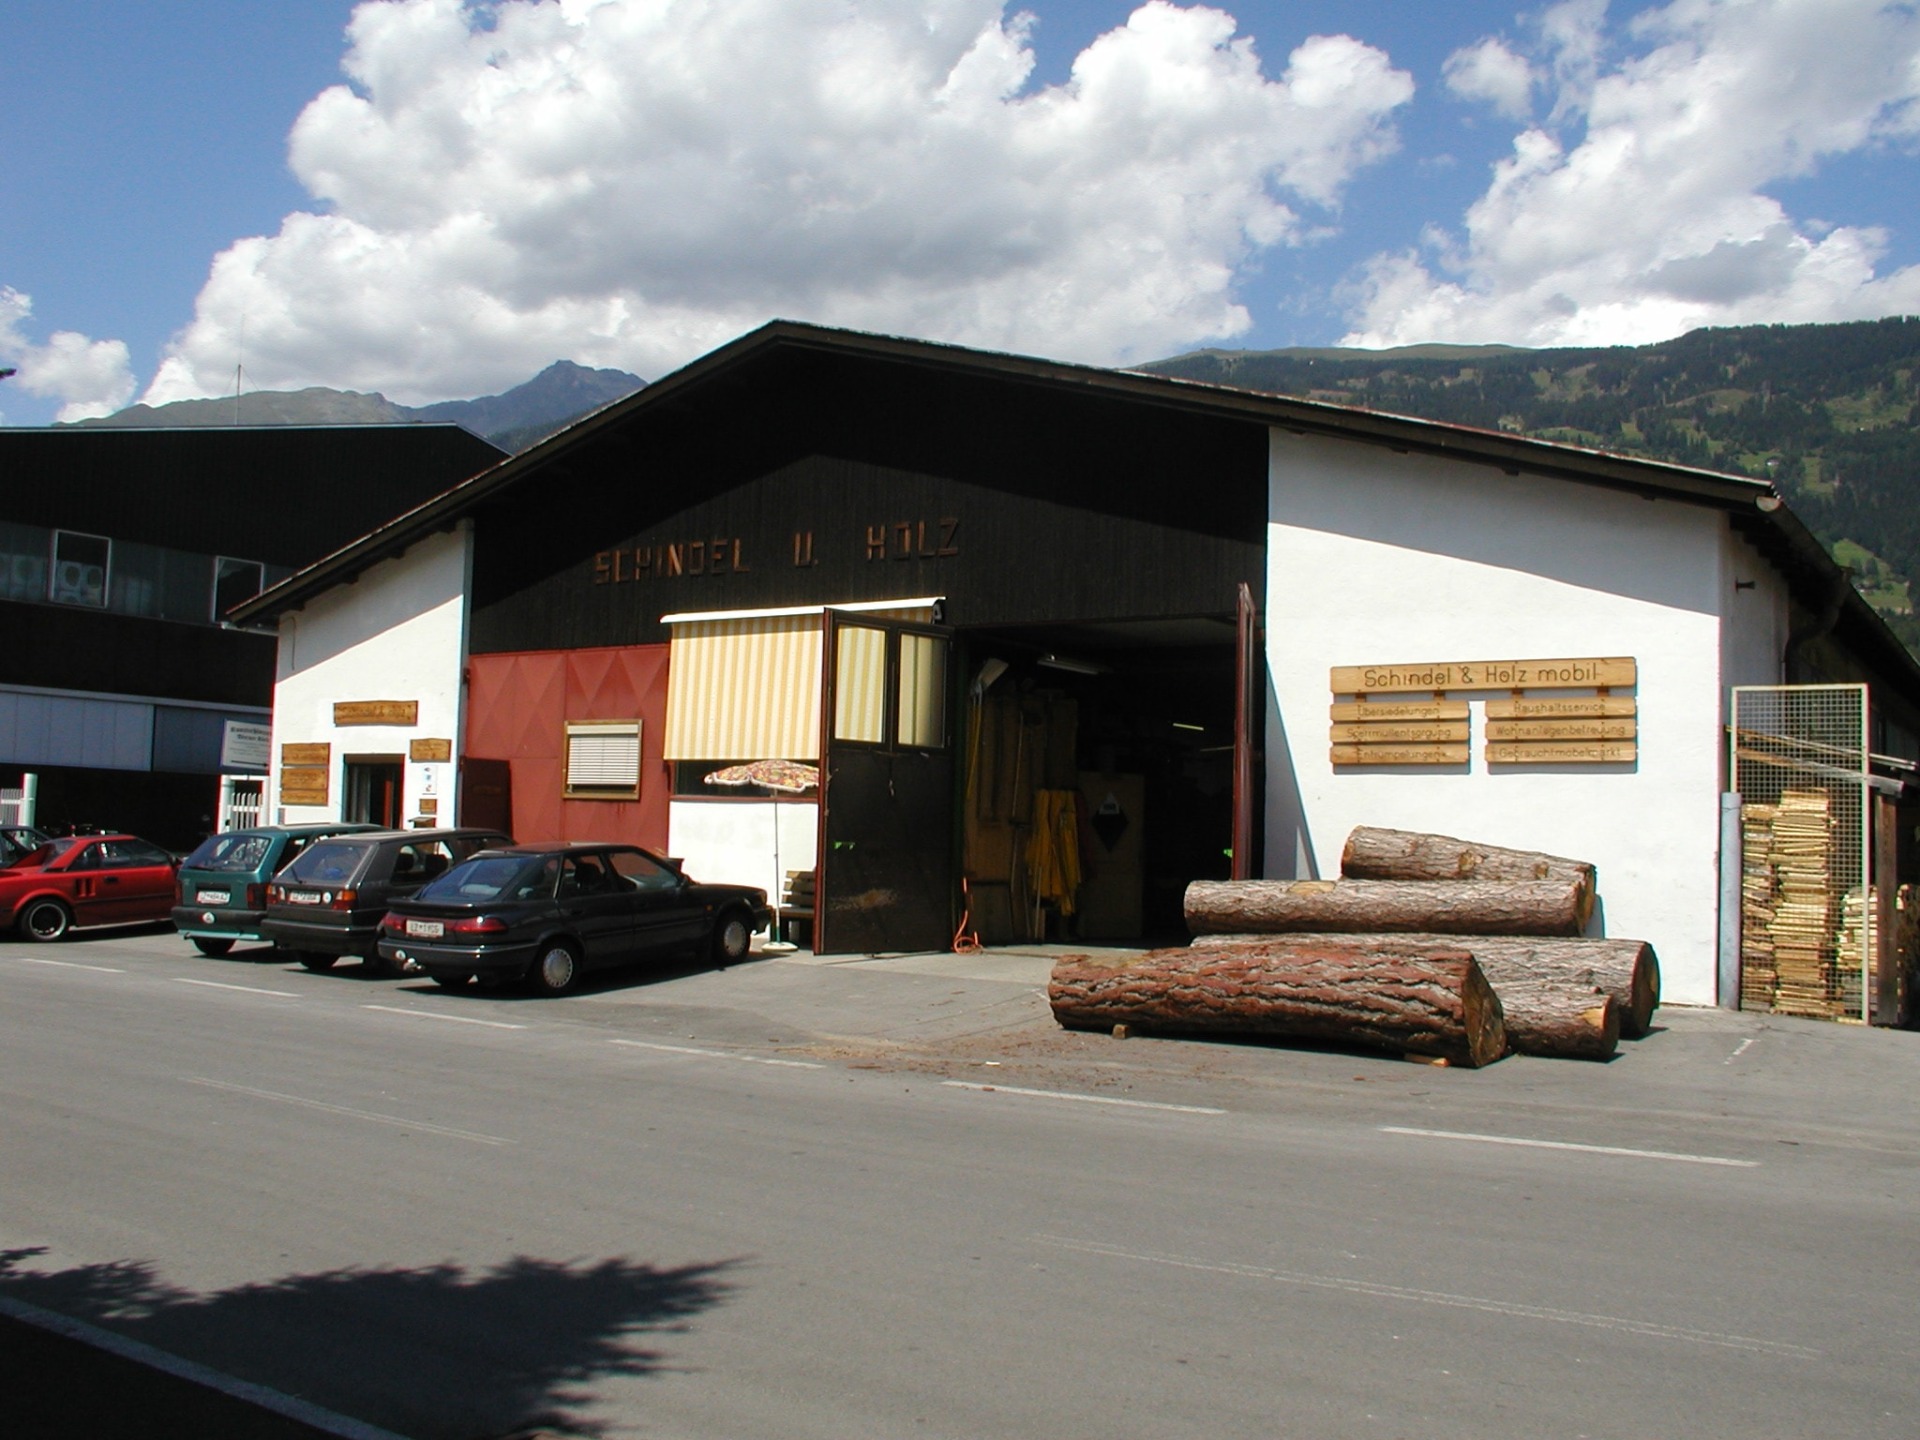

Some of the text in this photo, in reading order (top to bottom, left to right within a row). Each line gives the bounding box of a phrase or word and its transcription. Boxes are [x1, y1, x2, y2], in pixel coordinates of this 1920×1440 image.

[594, 538, 750, 585] SCHINDEL
[866, 518, 958, 561] HOLZ
[1364, 662, 1597, 688] Schindel & Holz mobil
[1514, 702, 1606, 713] Haushaltsservice
